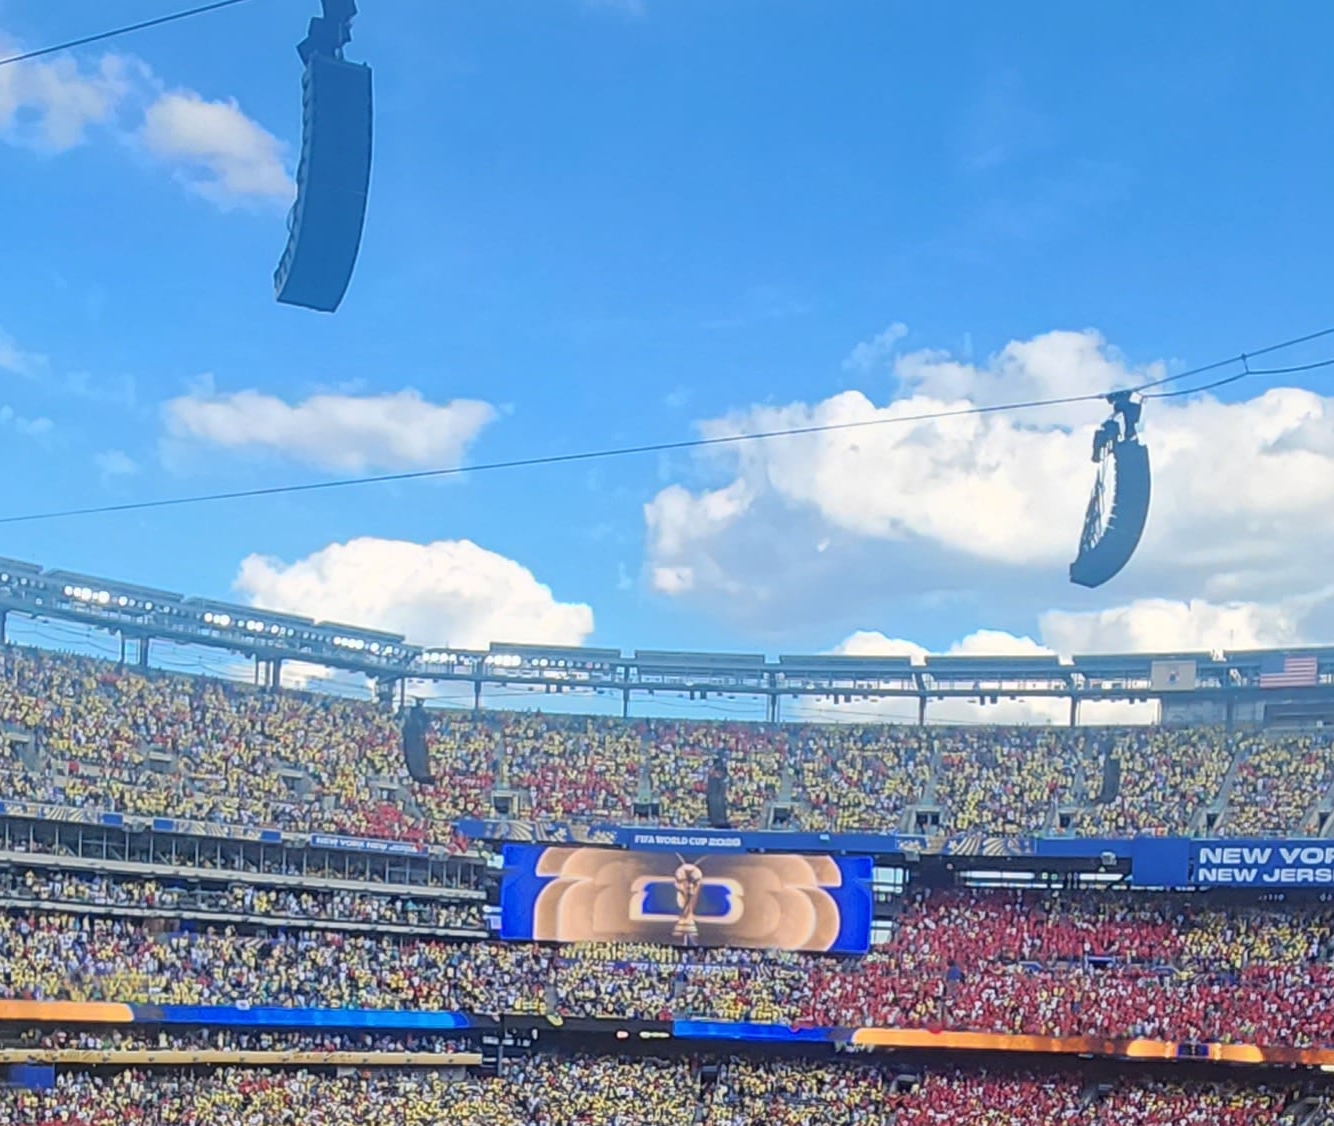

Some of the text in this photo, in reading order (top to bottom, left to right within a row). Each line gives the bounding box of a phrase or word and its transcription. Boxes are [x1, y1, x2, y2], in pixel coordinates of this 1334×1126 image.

[634, 834, 655, 844] FIFA
[655, 835, 688, 845] WORLD
[688, 837, 707, 846] CUP
[1199, 847, 1272, 864] NEW
[1198, 868, 1258, 882] NEW
